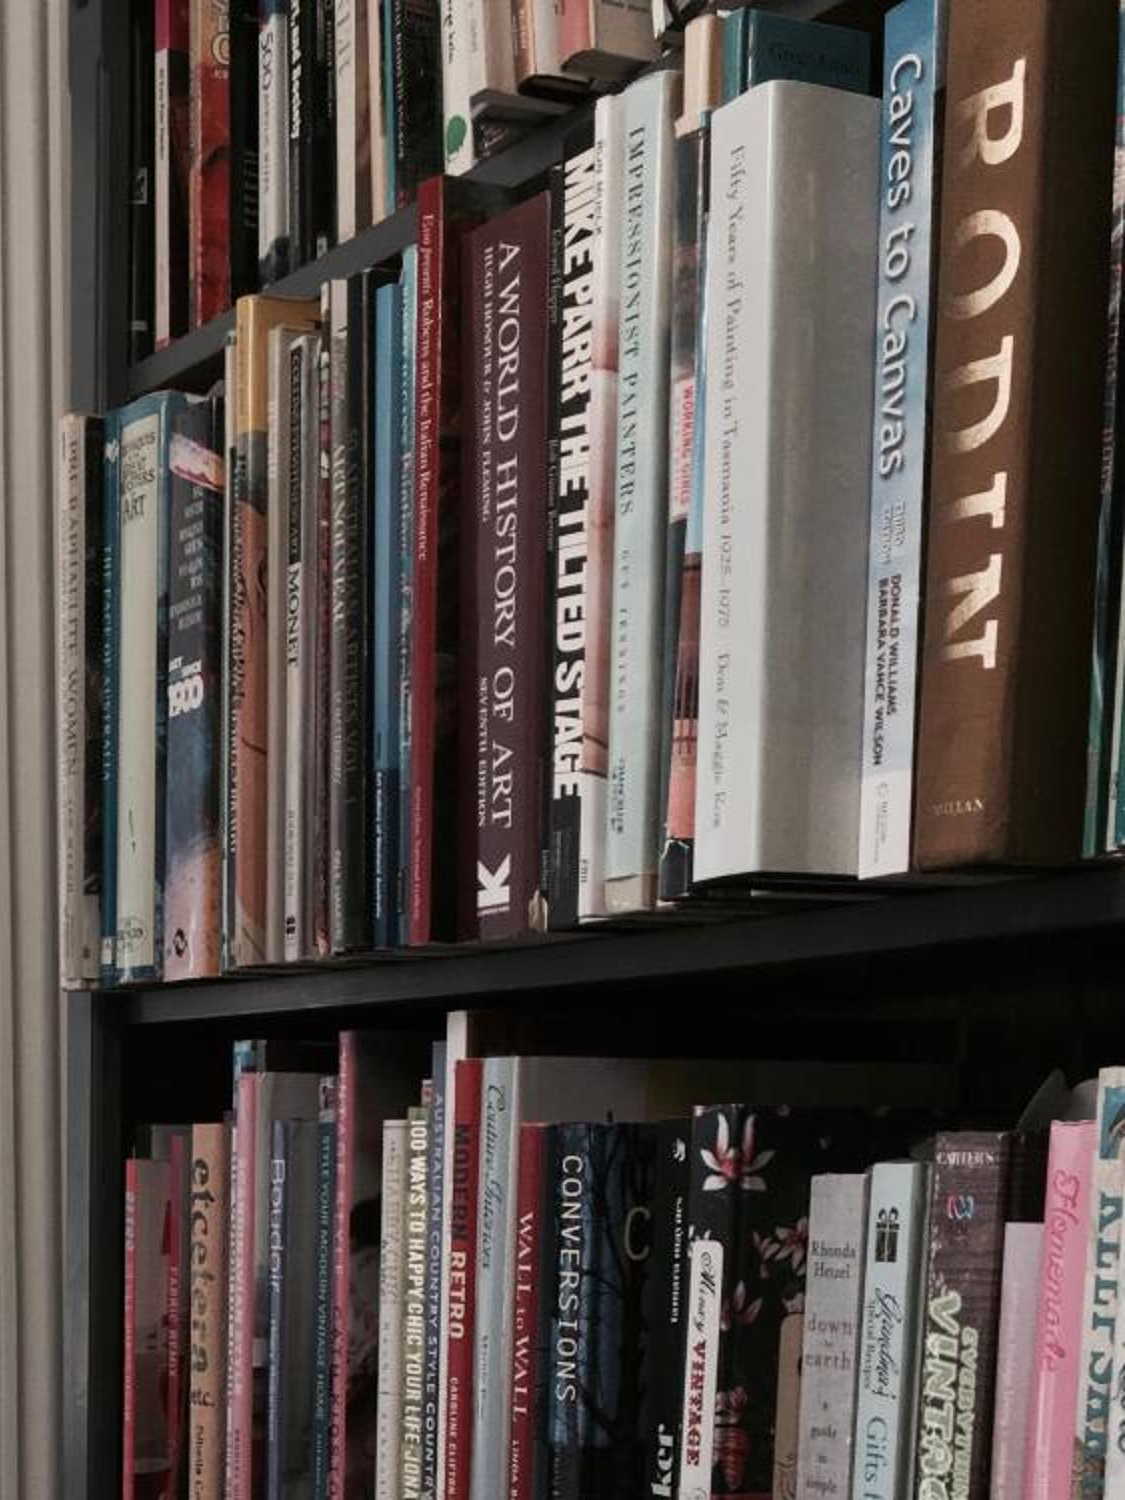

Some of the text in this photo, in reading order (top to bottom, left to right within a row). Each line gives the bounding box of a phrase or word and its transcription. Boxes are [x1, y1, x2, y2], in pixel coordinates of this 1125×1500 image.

[563, 146, 595, 274] MIKE
[727, 145, 746, 200] Fifty
[878, 52, 924, 477] Caves to Canvas
[419, 298, 434, 357] Rubens
[482, 301, 494, 377] HONOUR
[560, 270, 593, 402] PARR
[619, 126, 647, 517] IMPRESSIONIST PAINTERS
[720, 299, 741, 391] Painting
[939, 58, 1027, 670] RODIN
[419, 360, 432, 390] and
[480, 450, 492, 524] FLEMING
[559, 405, 590, 496] THE
[417, 472, 430, 562] Renaissance
[491, 241, 521, 830] A WORLD HISTORY OF ART
[287, 567, 300, 668] MONET
[554, 505, 588, 653] TILTED
[871, 577, 888, 766] BARBARA VANCE WILSON
[885, 574, 903, 716] DONALD WILLIAMS
[553, 660, 587, 801] STAGE
[321, 1136, 330, 1176] STYLE
[410, 1120, 427, 1151] 100
[410, 1156, 427, 1205] WAYS
[432, 1094, 444, 1221] AUSTRALIAN
[270, 1159, 285, 1294] Boudoir
[319, 1182, 330, 1226] YOUR
[410, 1210, 427, 1230] TO
[452, 1123, 471, 1240] MODERN
[408, 1238, 426, 1296] HAPPY
[429, 1230, 440, 1328] COUNTRY
[449, 1250, 466, 1340] RETRO
[516, 1212, 534, 1302] WALL
[554, 1154, 583, 1405] CONVERSIONS
[408, 1303, 427, 1346] CHIC
[425, 1337, 439, 1394] STYLE
[804, 1352, 851, 1372] earth
[405, 1352, 426, 1401] YOUR
[512, 1335, 530, 1424] WALL
[686, 1340, 707, 1467] VINTAGE
[863, 1416, 888, 1483] Gifts
